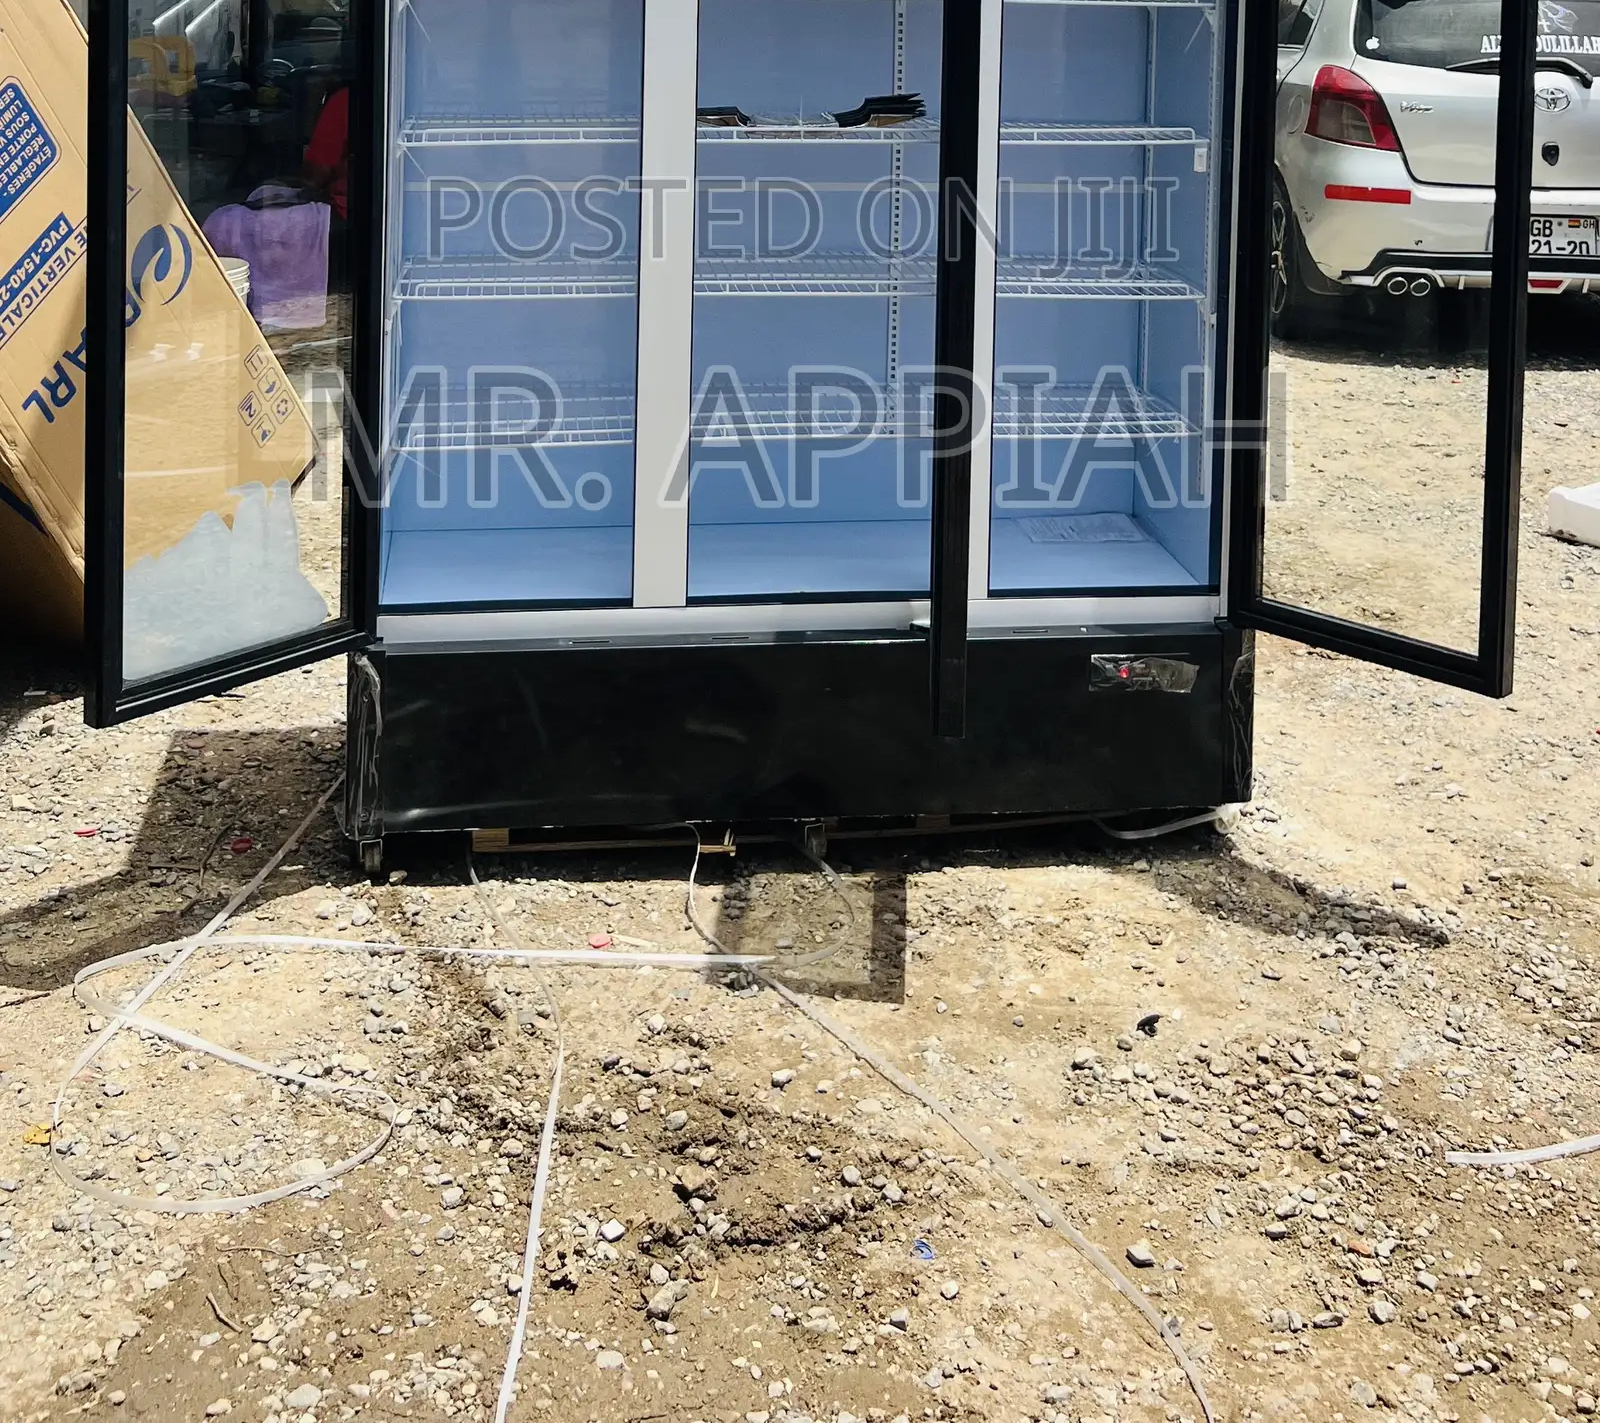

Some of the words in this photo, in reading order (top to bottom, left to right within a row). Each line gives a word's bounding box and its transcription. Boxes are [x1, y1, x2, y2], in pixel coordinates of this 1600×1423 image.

[5, 111, 30, 139] SOUS
[7, 122, 38, 156] PORTE
[1582, 219, 1595, 229] GH
